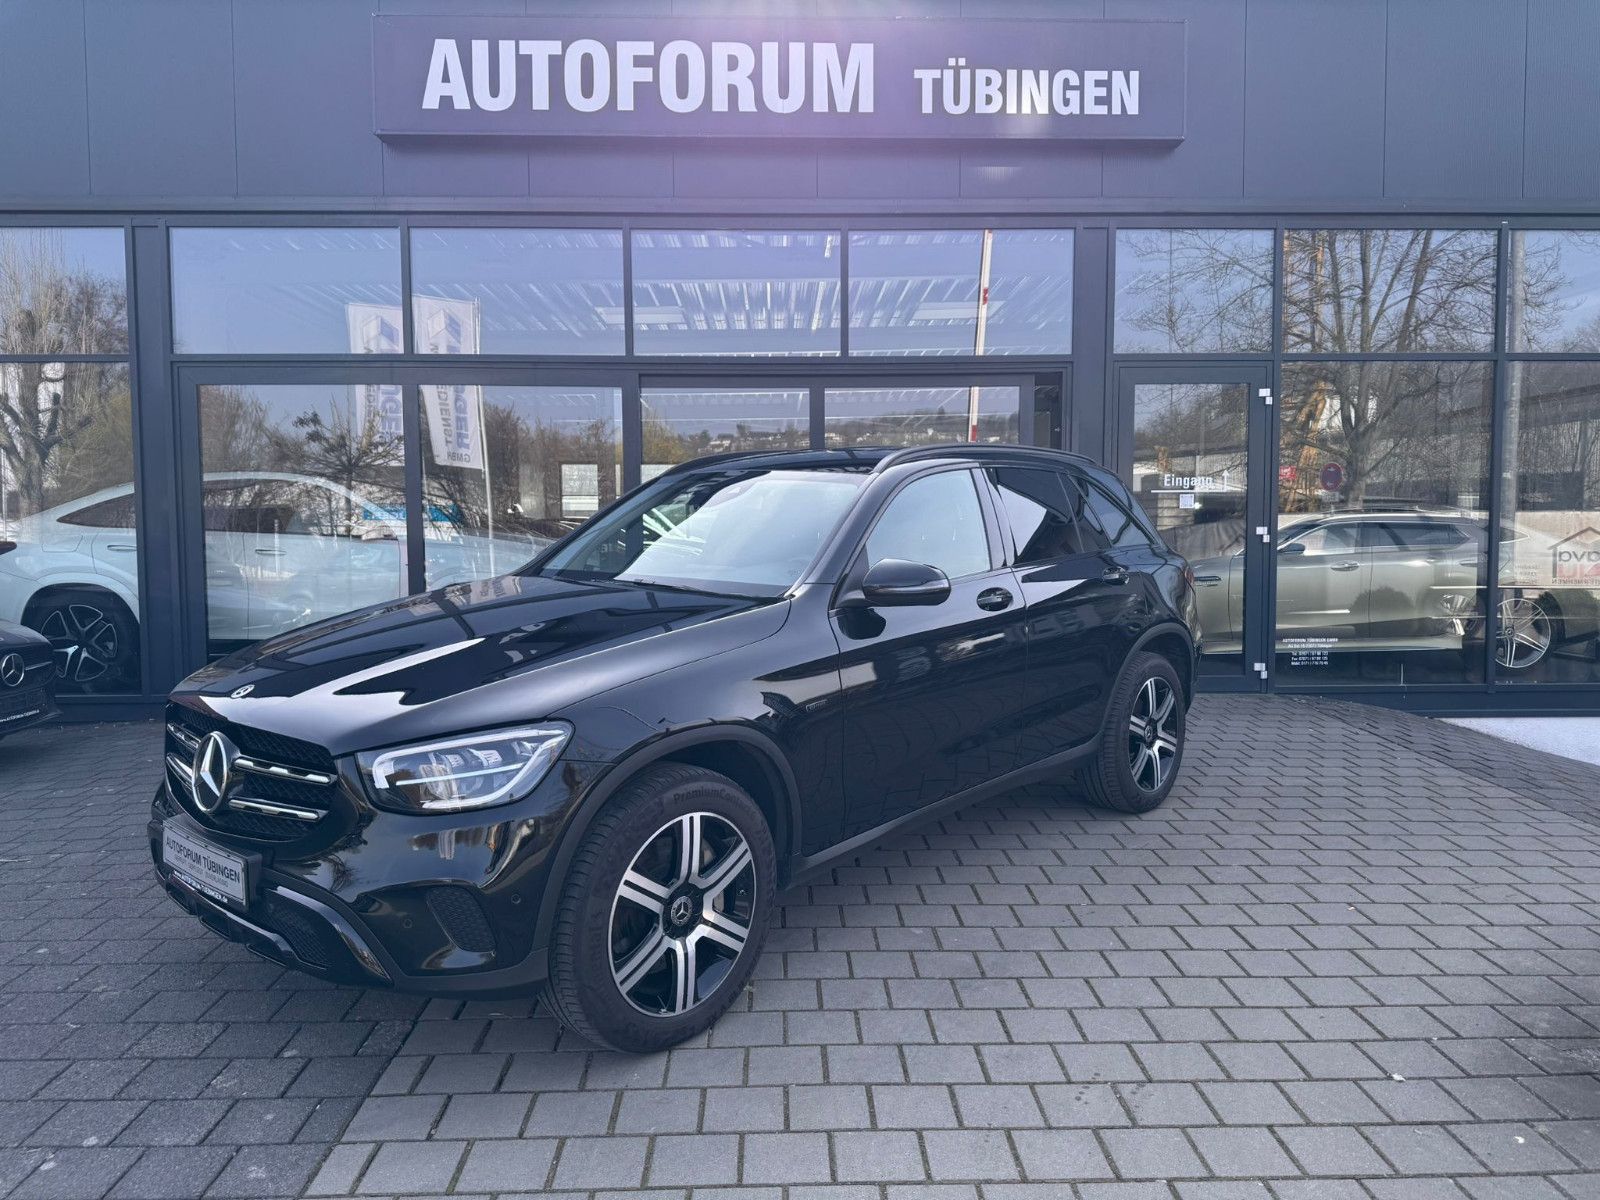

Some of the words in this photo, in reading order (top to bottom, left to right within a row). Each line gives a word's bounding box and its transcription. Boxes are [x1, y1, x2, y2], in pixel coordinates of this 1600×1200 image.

[421, 38, 876, 115] AUTOFORUM
[914, 57, 1140, 117] TÜBINGEN
[1163, 473, 1213, 491] Eingang
[166, 836, 202, 866] AUTOFORUM
[202, 855, 241, 883] TÜBINGEN
